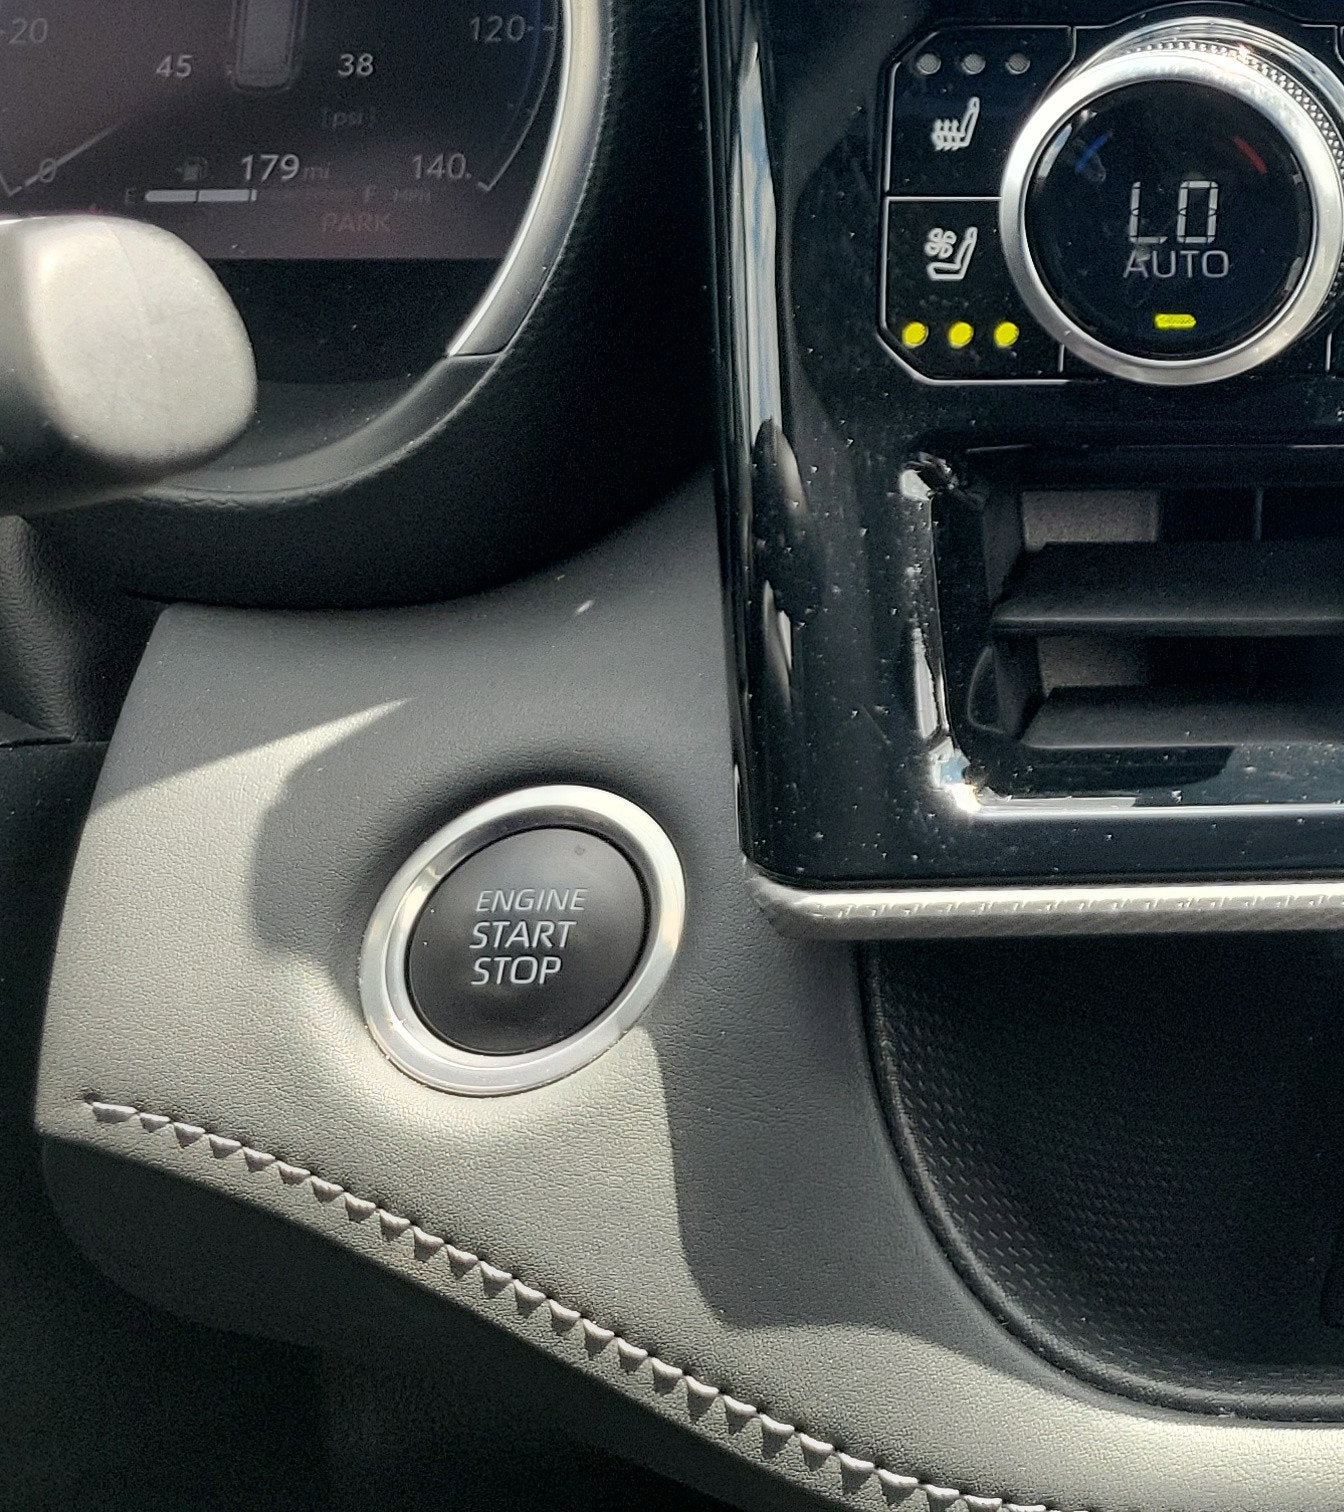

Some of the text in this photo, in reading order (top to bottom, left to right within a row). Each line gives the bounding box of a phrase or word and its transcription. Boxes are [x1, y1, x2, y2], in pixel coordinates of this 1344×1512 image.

[9, 18, 48, 44] 20
[469, 15, 525, 41] 120
[156, 55, 193, 77] 45
[338, 54, 373, 77] 38
[241, 154, 330, 181] 179 mi
[322, 213, 390, 233] PARK
[1123, 250, 1230, 279] AUTO
[476, 888, 589, 913] ENGINE
[469, 920, 578, 950] START
[470, 955, 563, 986] STOP
